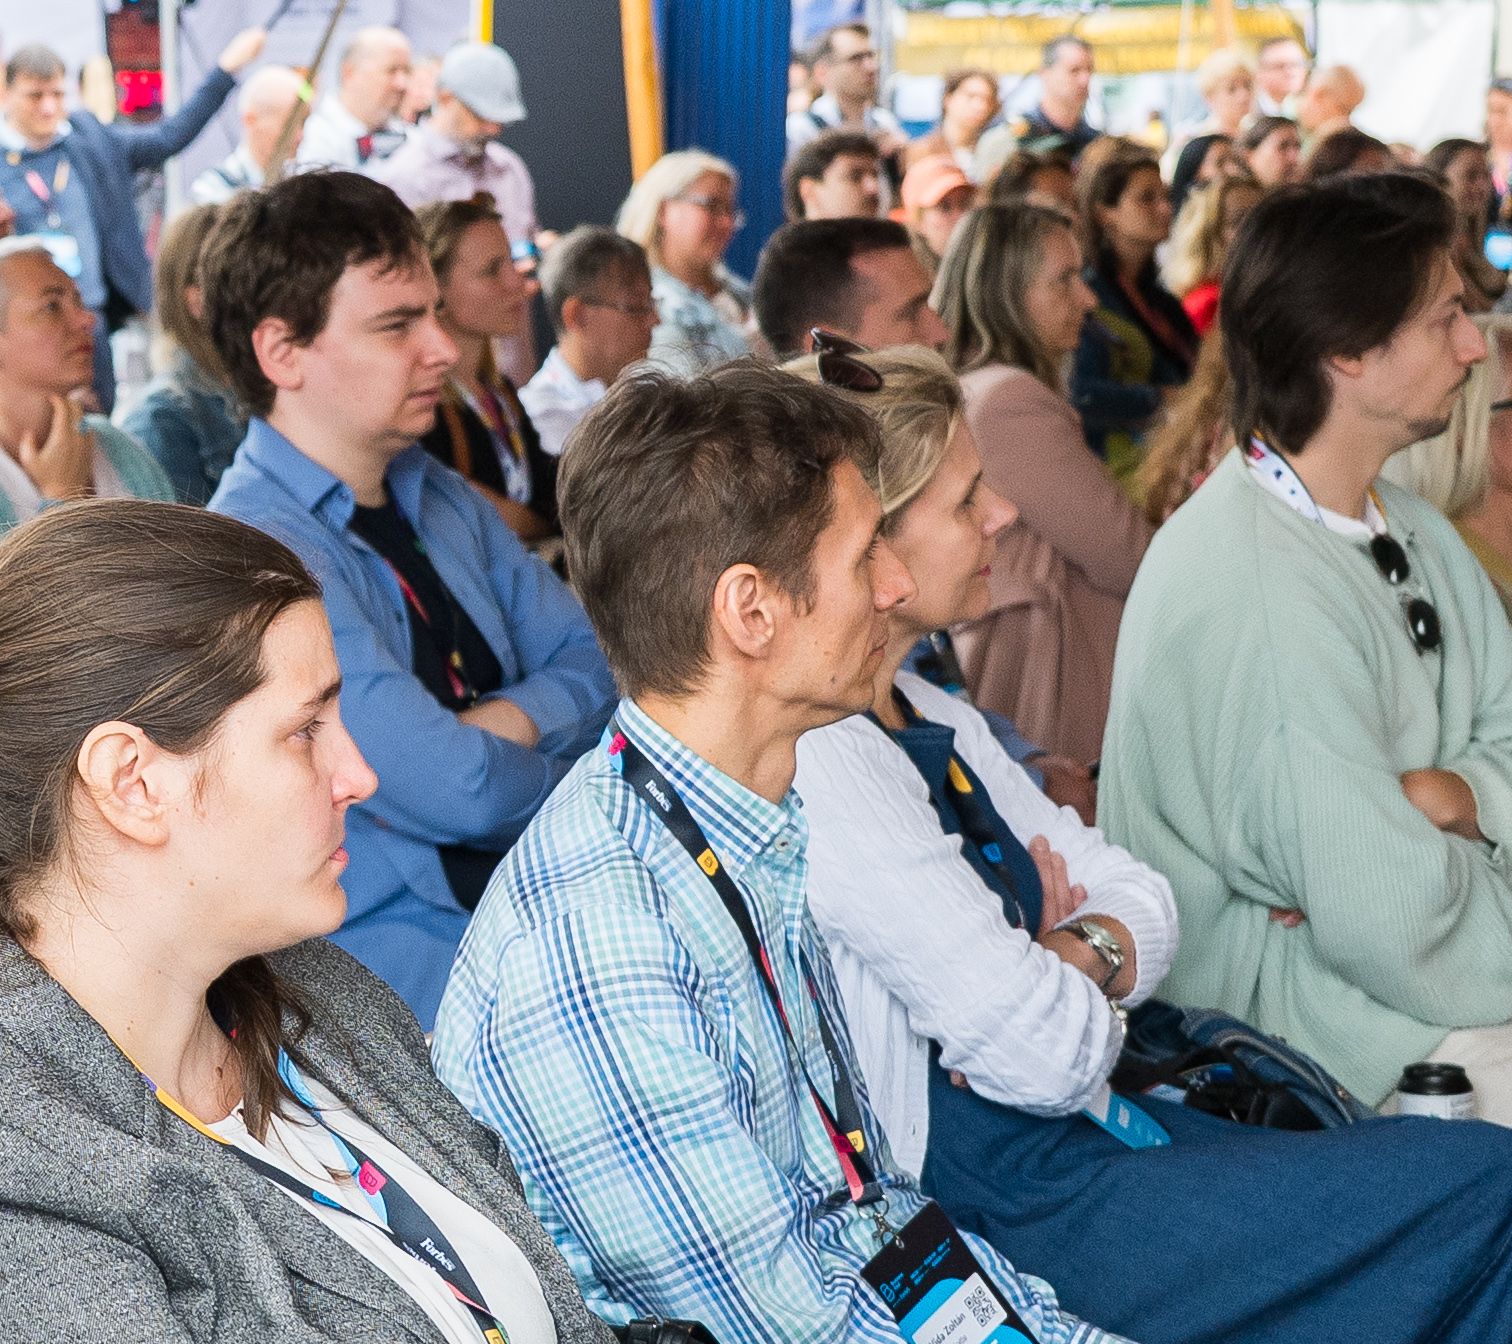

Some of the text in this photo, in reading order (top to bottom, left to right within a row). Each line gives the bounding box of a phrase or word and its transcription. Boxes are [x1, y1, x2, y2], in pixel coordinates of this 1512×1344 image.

[645, 779, 673, 813] Forbes
[419, 1236, 457, 1272] Forbes
[943, 1312, 966, 1337] Zoltán
